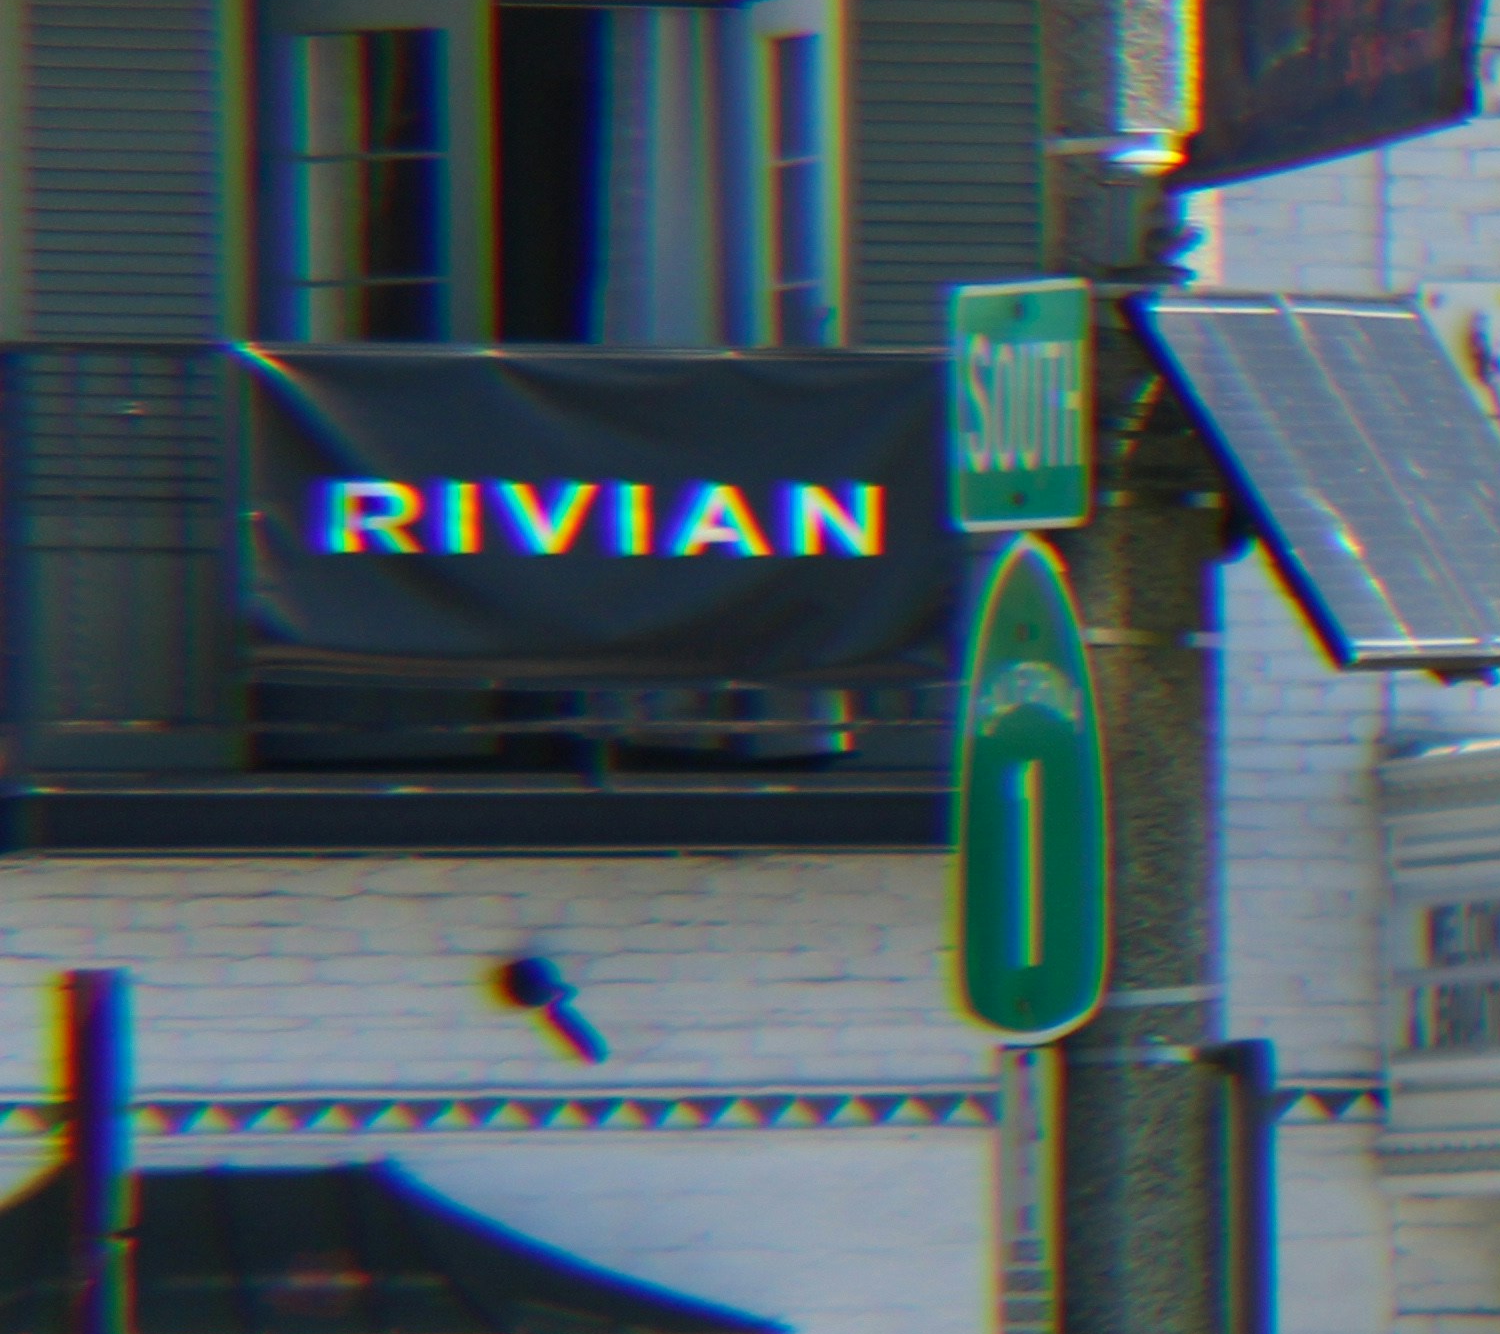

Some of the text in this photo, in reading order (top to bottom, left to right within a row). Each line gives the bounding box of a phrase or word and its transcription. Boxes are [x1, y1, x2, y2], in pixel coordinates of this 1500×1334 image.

[956, 333, 1082, 473] SOUTH
[318, 478, 886, 557] RIVIAN
[1006, 758, 1043, 968] 1
